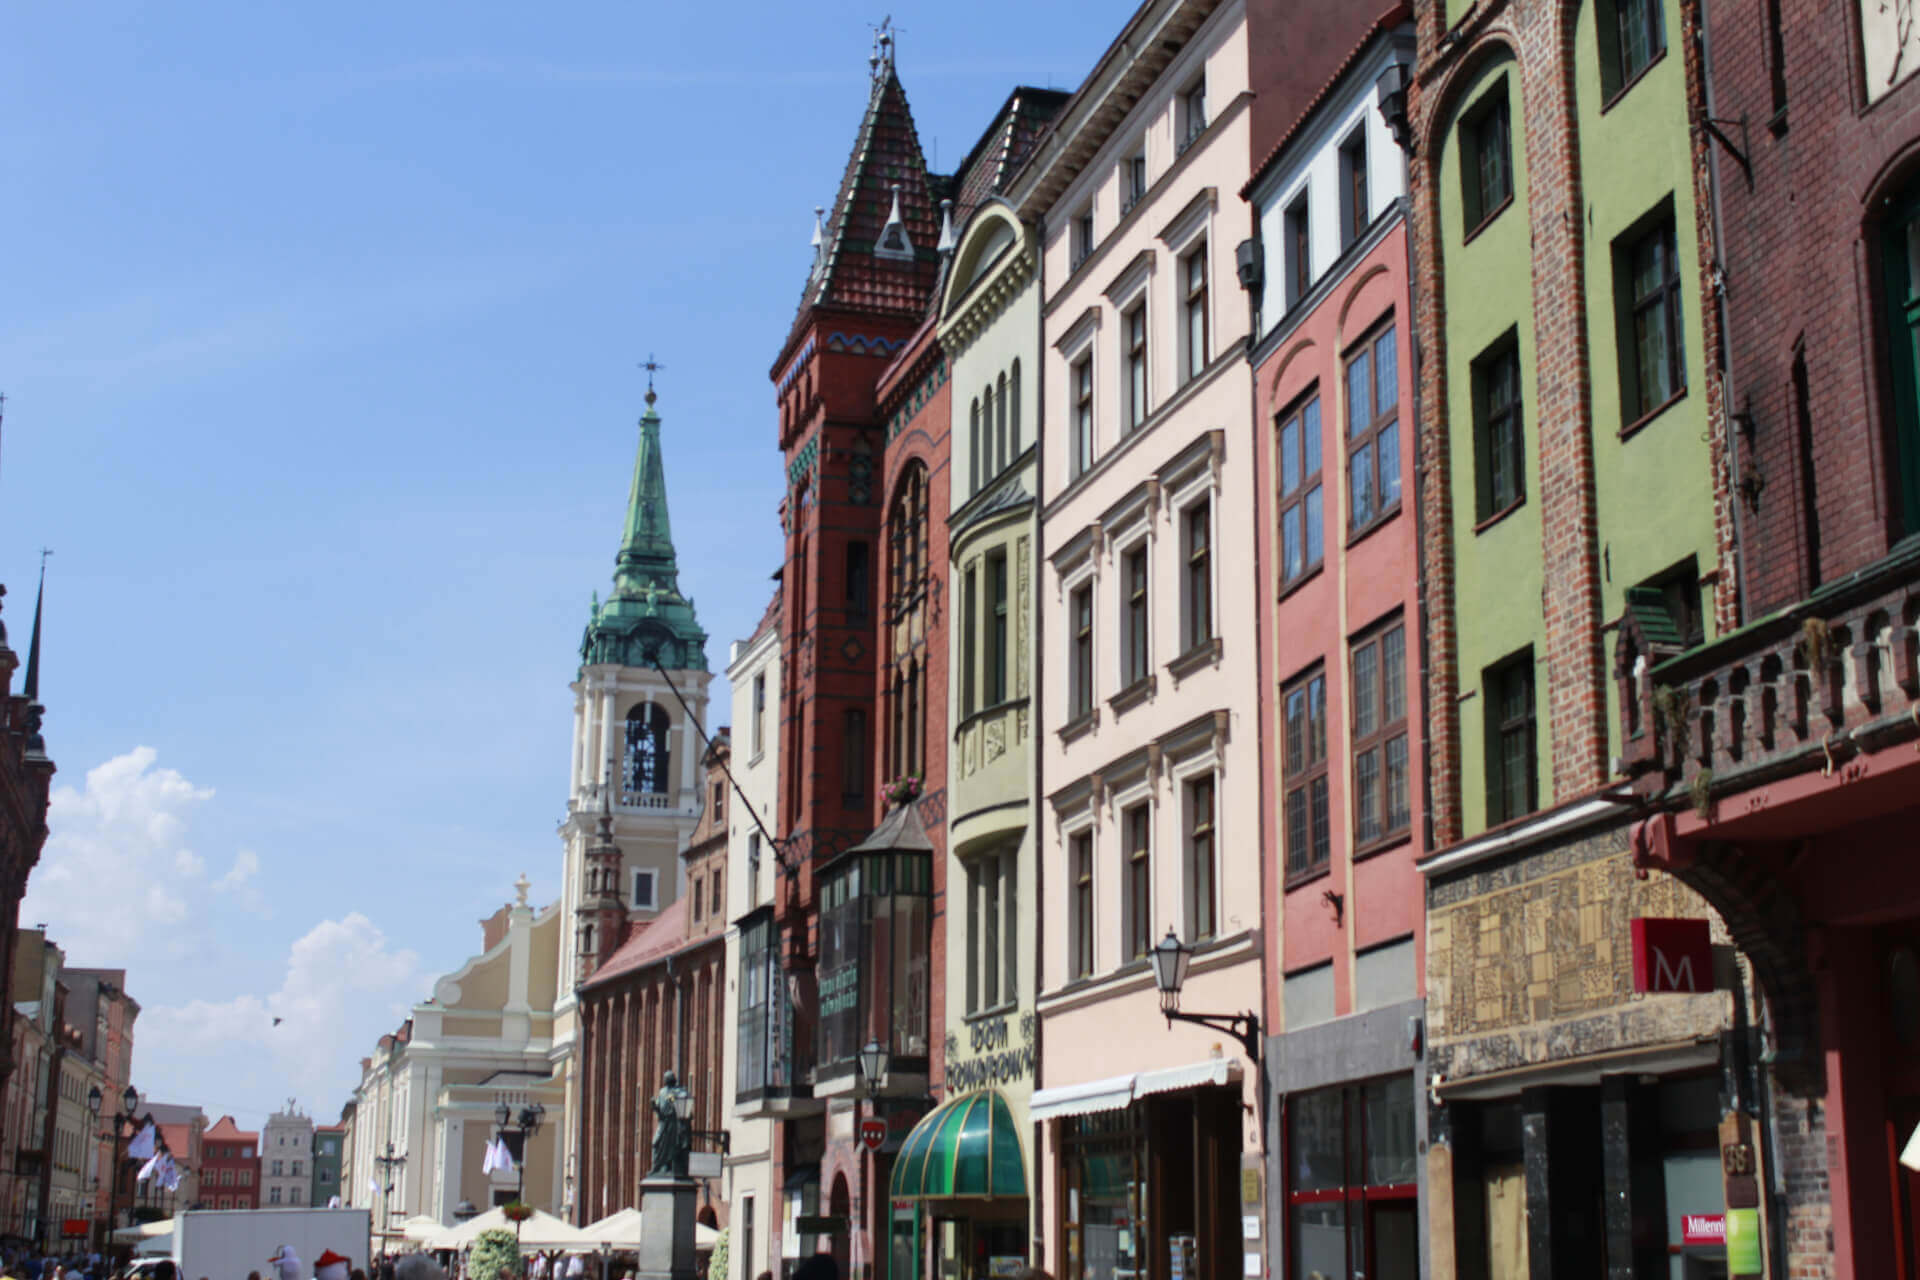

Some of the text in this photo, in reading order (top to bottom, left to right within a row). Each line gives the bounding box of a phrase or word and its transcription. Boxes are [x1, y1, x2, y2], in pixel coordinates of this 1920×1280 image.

[1652, 945, 1696, 992] M
[970, 1016, 1009, 1053] DOM
[944, 1044, 1036, 1095] TOWAROWY
[1725, 1144, 1748, 1173] 38
